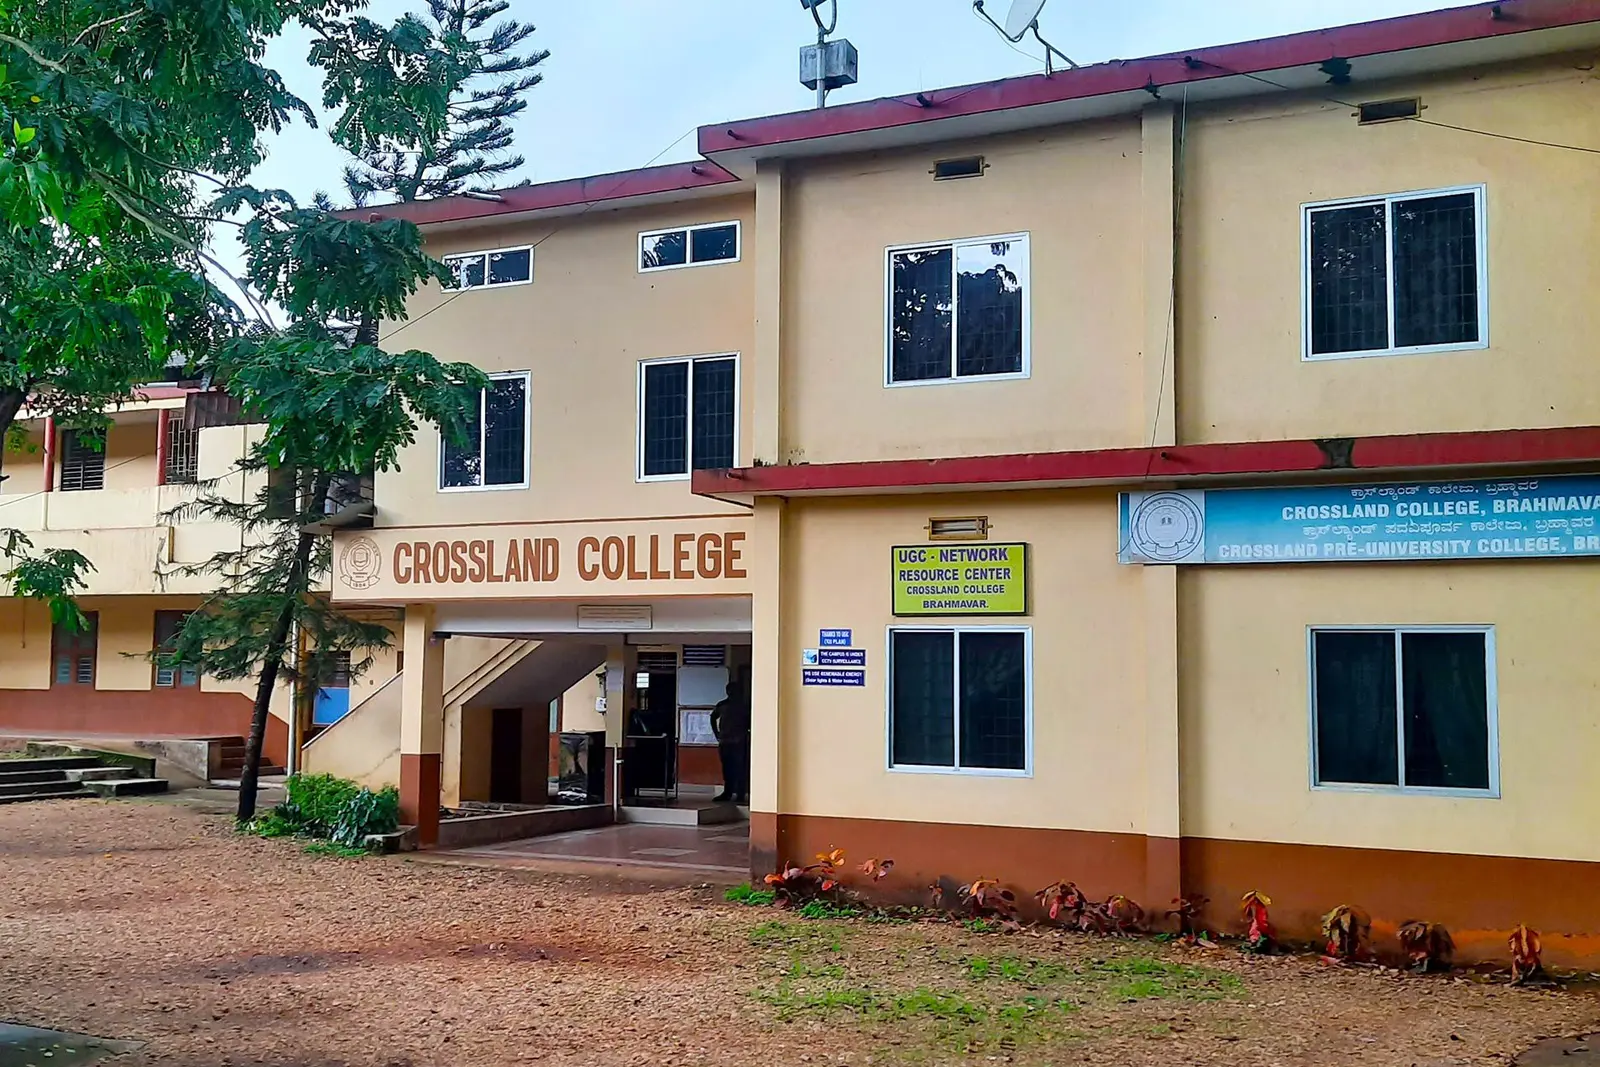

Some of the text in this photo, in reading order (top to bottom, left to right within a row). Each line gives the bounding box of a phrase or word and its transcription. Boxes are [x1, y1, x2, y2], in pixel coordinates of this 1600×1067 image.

[1281, 503, 1390, 521] CROSSLAND
[1395, 500, 1487, 517] COLLEGE,
[898, 549, 927, 563] UGC
[939, 547, 1009, 562] NETWORK
[1218, 542, 1318, 559] CROSSLAND
[1323, 538, 1472, 557] PRE-UNIVERSITY
[1477, 536, 1567, 554] COLLEGE,
[392, 537, 560, 584] CROSSLAND
[577, 531, 748, 582] COLLEGE
[899, 567, 1011, 581] RESOURCE CENTER
[906, 584, 1005, 595] CROSSLAND COLLEGE
[922, 600, 989, 609] BRAHMAVAR.
